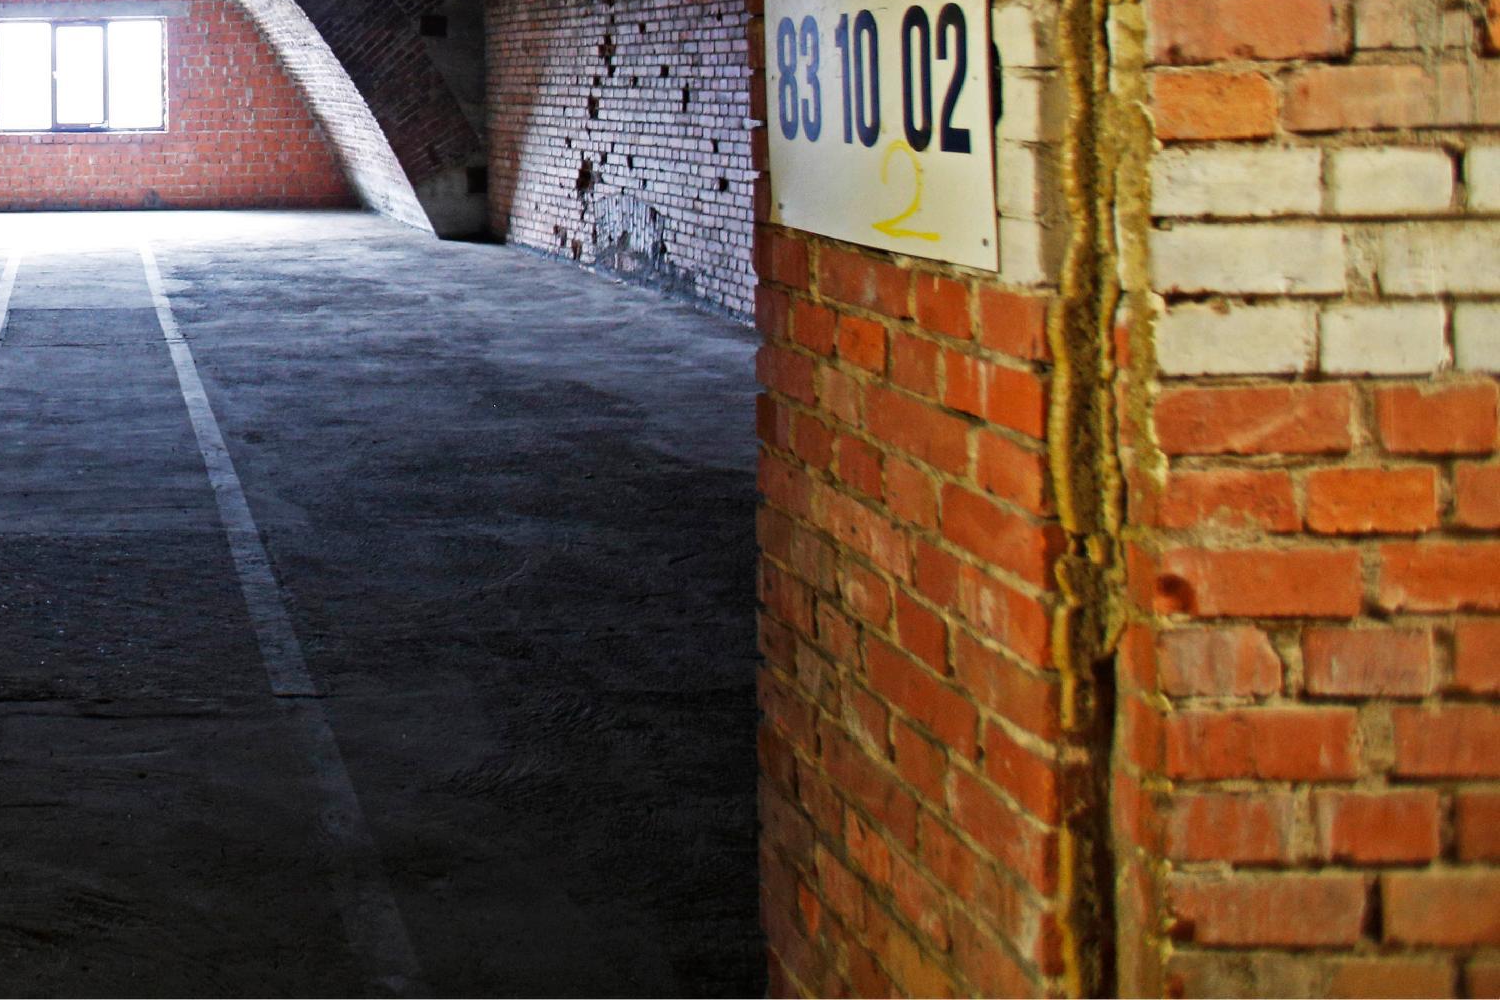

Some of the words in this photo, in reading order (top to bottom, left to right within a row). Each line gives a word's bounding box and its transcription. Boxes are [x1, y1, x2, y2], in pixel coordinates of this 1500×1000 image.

[776, 15, 822, 142] 83
[835, 8, 881, 148] 10
[901, 2, 971, 154] 02
[872, 138, 941, 242] 2
